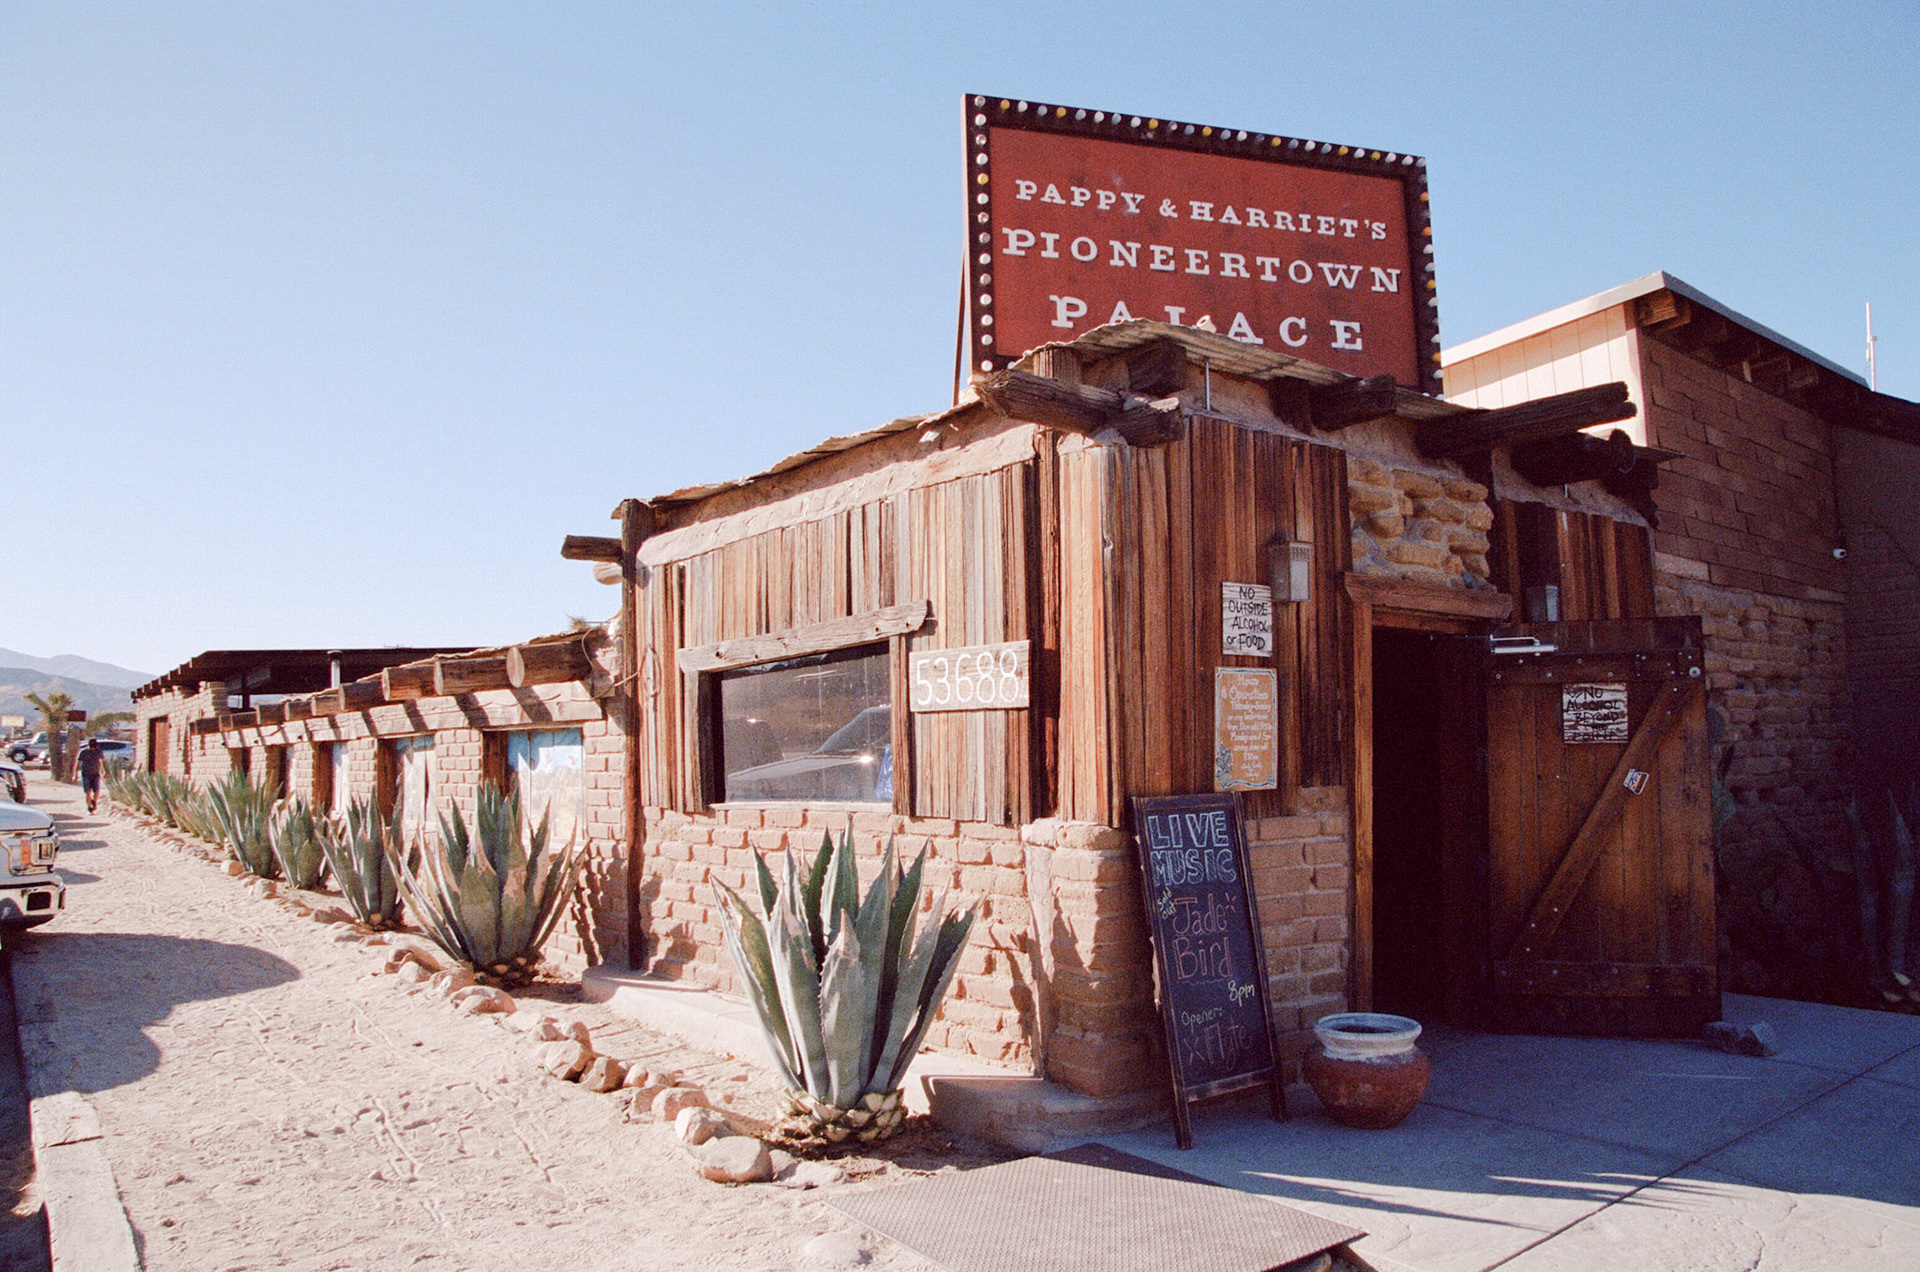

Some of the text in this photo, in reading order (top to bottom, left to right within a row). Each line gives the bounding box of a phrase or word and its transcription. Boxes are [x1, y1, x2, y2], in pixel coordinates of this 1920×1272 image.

[1015, 179, 1387, 240] PAPPY & HARRIET'S
[1002, 227, 1401, 293] PIONEERTOWN
[1239, 586, 1255, 600] NO
[1228, 599, 1268, 616] OUTSIDE
[1231, 616, 1268, 633] ALCOHOL
[1238, 633, 1265, 651] FOOD
[916, 649, 1019, 705] 53688
[1566, 699, 1621, 712] ALCOHOL
[1583, 686, 1604, 700] NO
[1573, 711, 1619, 723] BEYOND
[1147, 811, 1229, 849] LIVE
[1150, 848, 1237, 886] MUSIC
[1157, 887, 1172, 912] Sold
[1172, 893, 1228, 935] Jade
[1172, 937, 1235, 980] Bird
[1227, 980, 1255, 1007] 8pm
[1181, 1007, 1223, 1034] Opener:
[1204, 1014, 1252, 1072] Flyte
